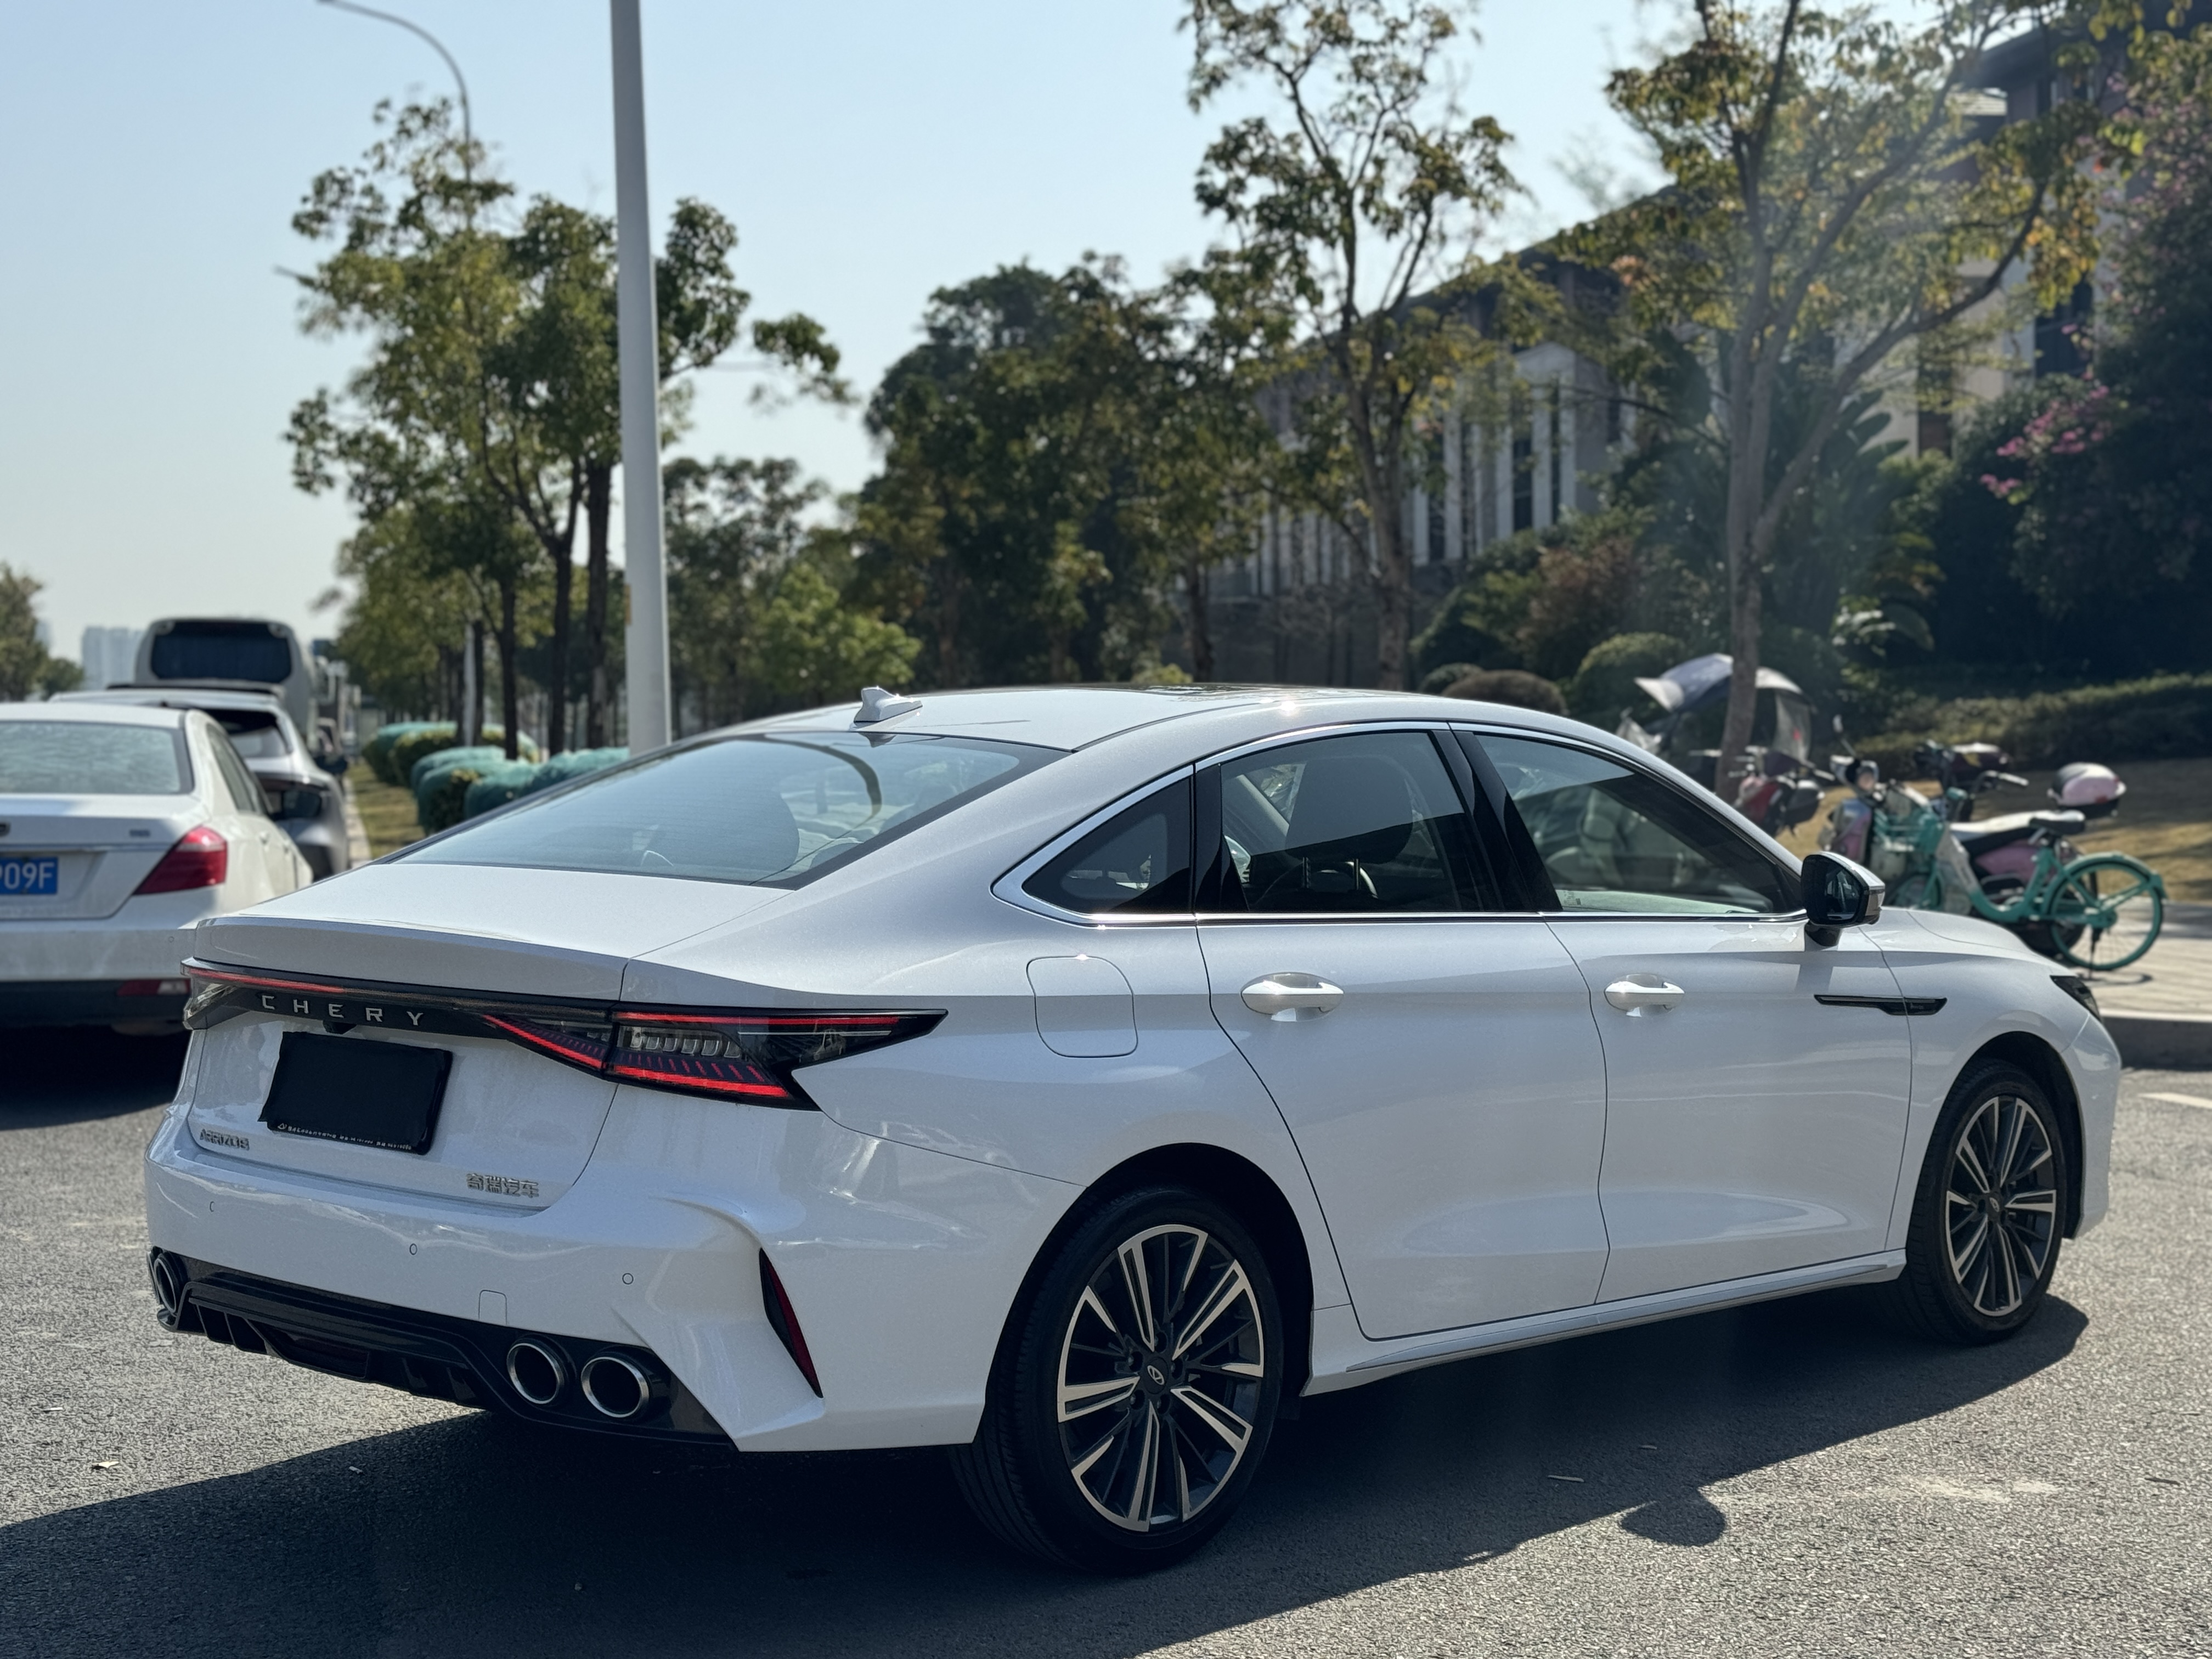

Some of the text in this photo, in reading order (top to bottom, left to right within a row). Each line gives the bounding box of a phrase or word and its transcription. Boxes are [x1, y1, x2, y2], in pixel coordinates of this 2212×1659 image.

[0, 861, 55, 890] 09F
[262, 994, 424, 1026] CHERY
[466, 1173, 539, 1198] 奇瑞汽车
